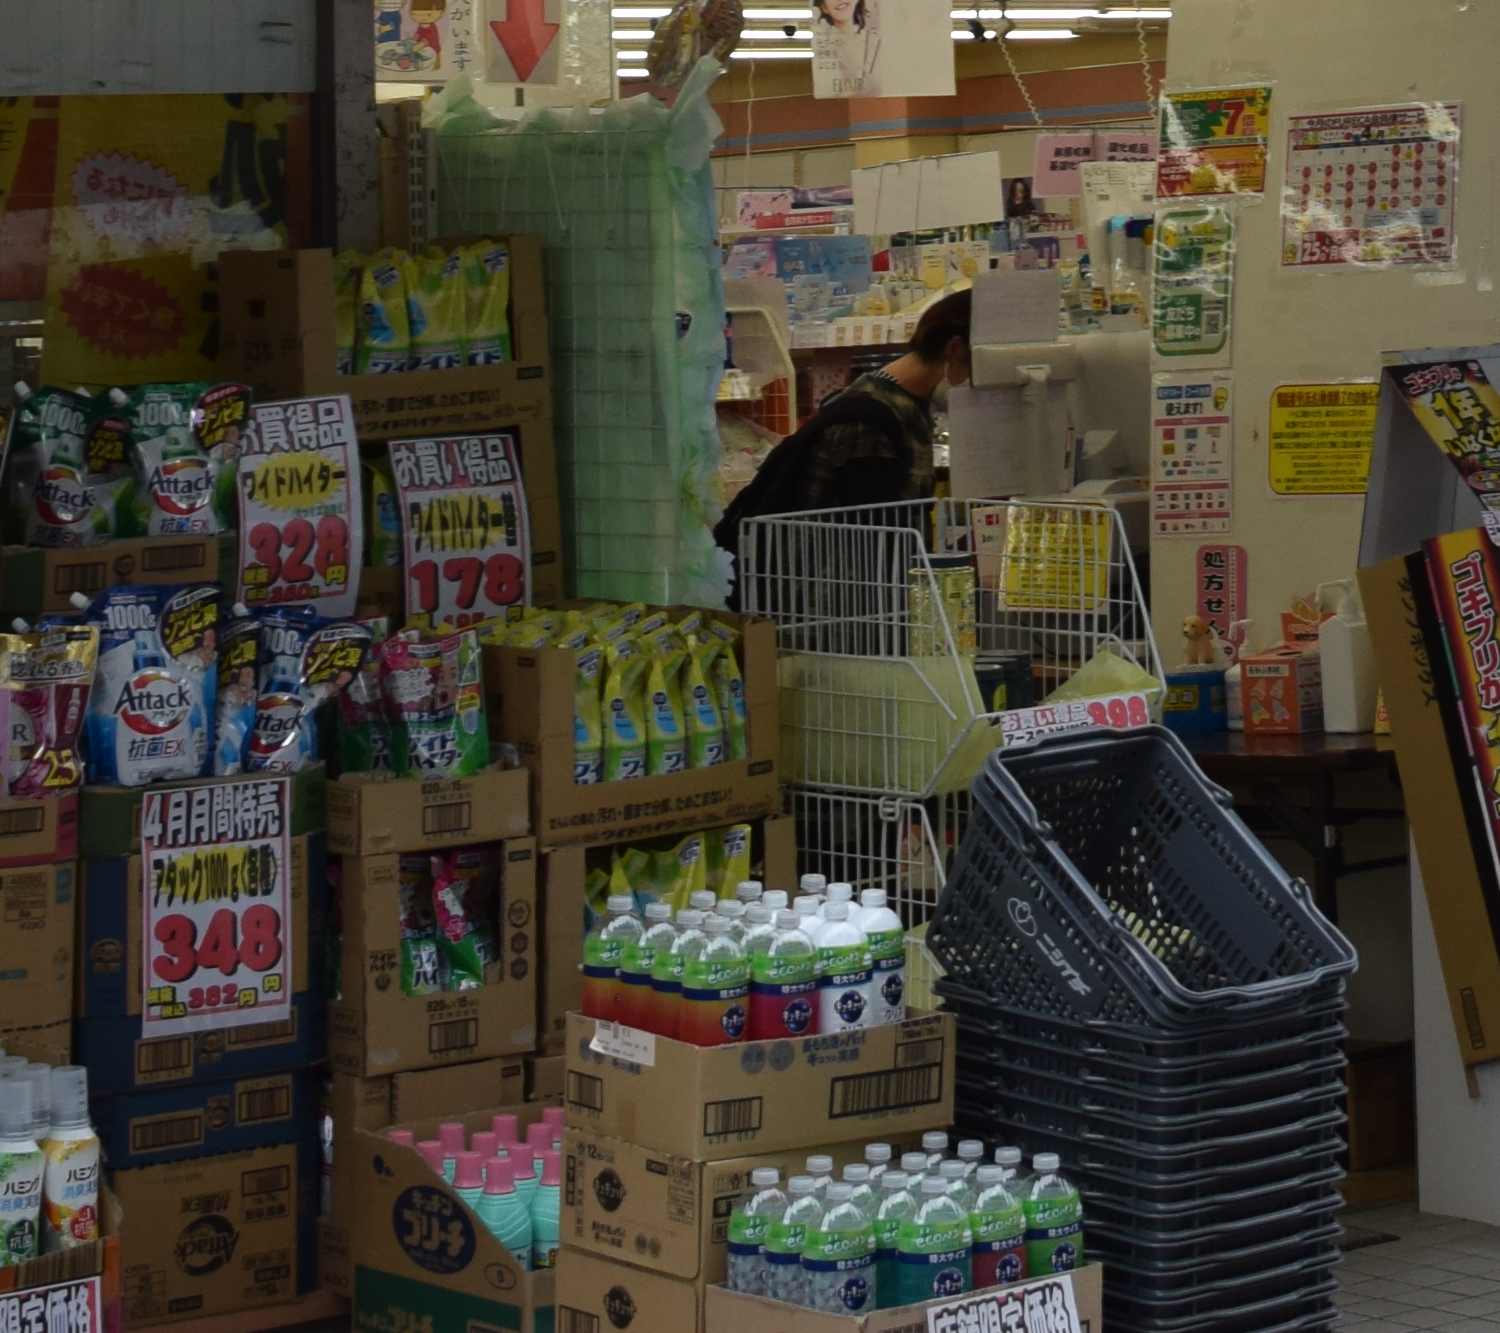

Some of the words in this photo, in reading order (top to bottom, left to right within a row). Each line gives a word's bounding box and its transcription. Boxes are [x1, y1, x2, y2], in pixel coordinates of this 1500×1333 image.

[150, 469, 215, 496] Attack
[393, 437, 514, 488] お買い得品
[250, 515, 348, 584] 328
[409, 552, 524, 612] 178
[113, 679, 192, 715] Attack
[143, 782, 281, 845] 4月月間特売
[152, 903, 281, 982] 348
